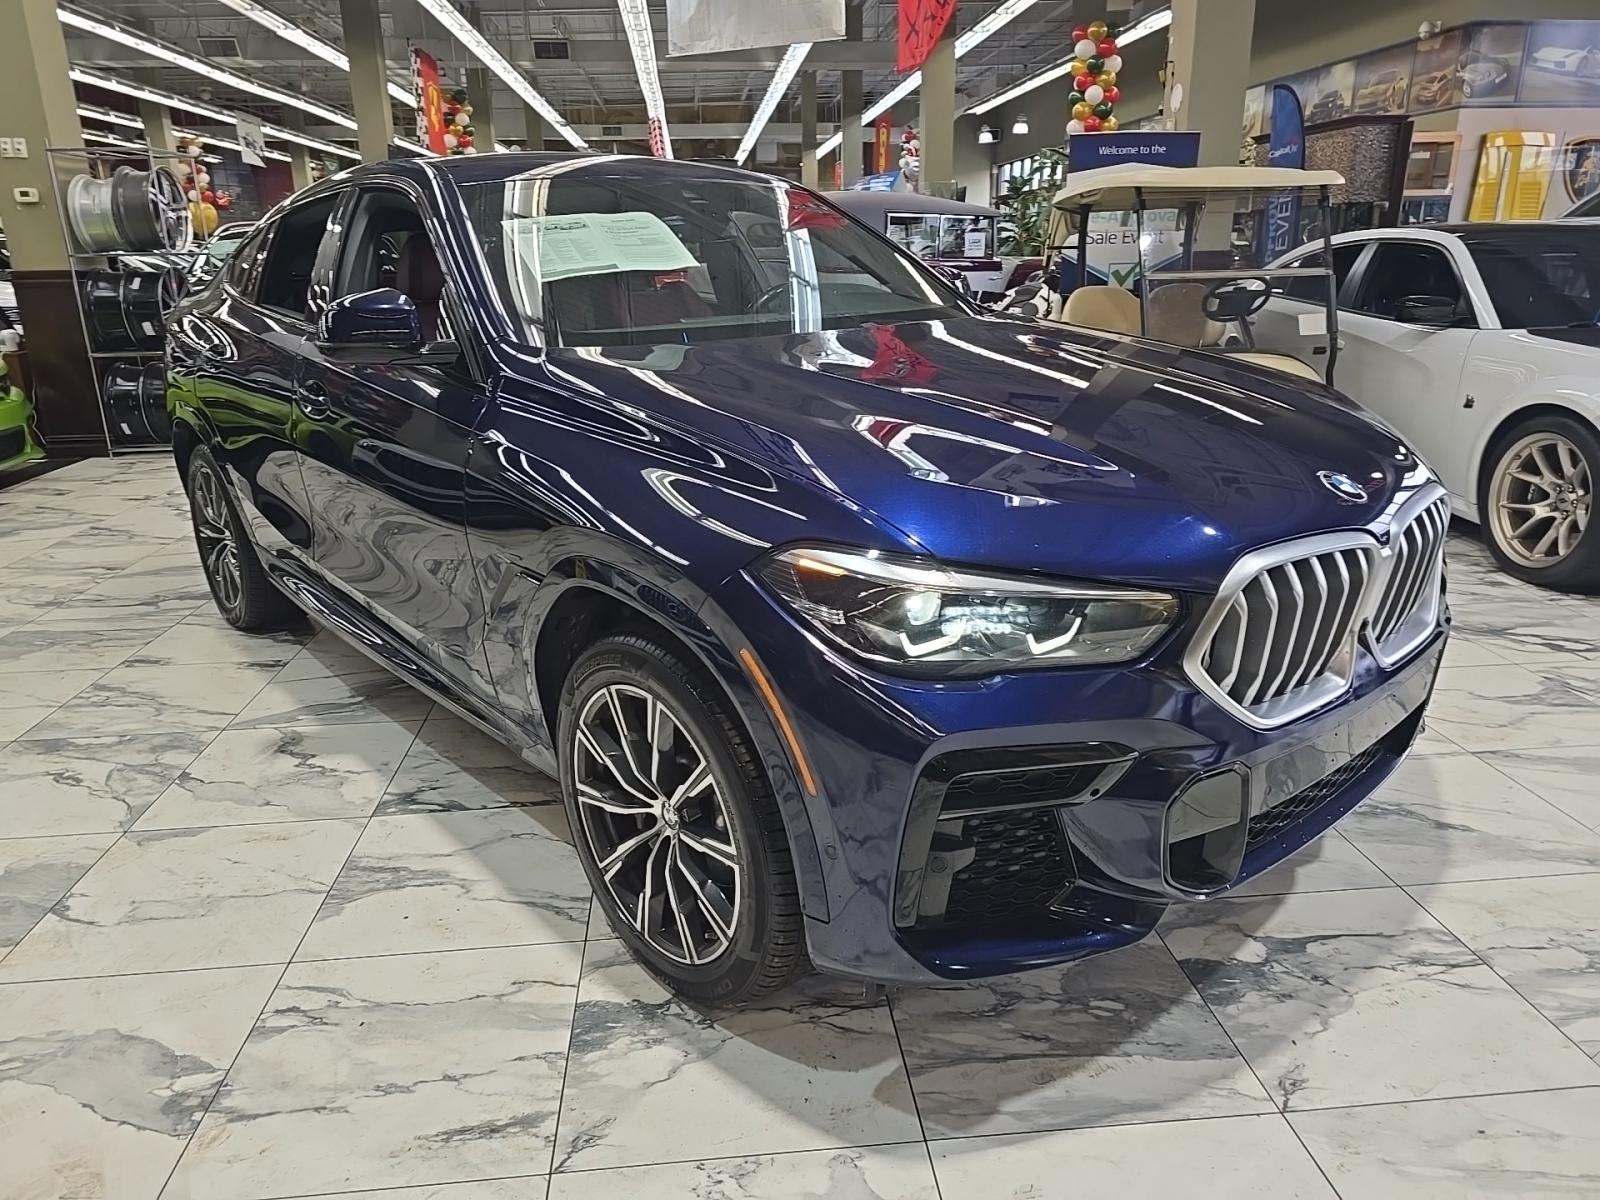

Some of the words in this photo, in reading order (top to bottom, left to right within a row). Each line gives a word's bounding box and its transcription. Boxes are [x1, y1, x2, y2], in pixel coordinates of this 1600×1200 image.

[1099, 145, 1139, 155] Welcome
[1140, 145, 1150, 154] to
[1151, 144, 1167, 154] the
[1085, 230, 1117, 245] Sale
